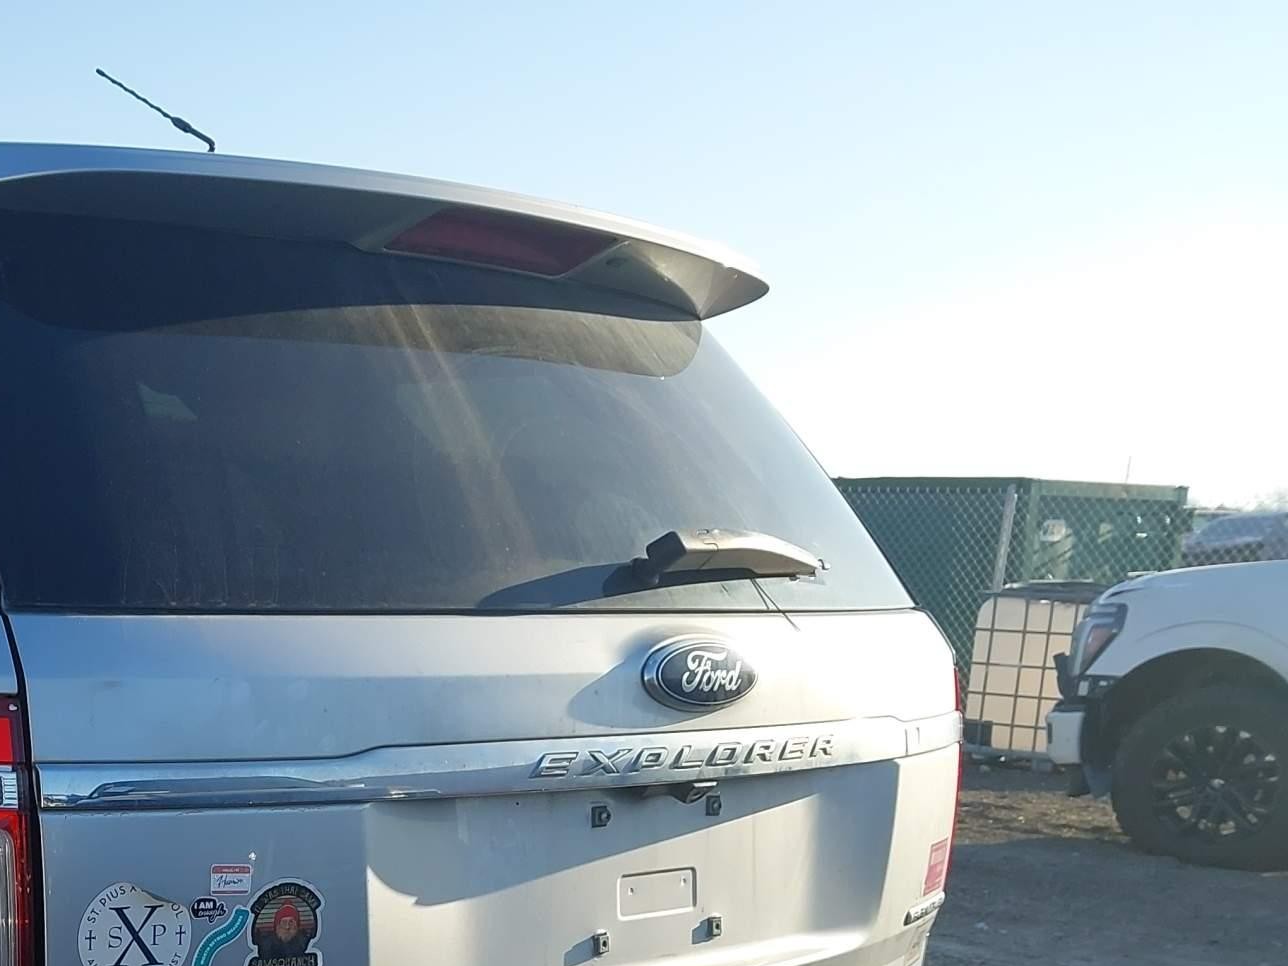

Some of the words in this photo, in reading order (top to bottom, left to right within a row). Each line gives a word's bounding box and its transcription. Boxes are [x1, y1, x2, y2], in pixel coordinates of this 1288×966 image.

[681, 650, 743, 693] Ford
[528, 734, 835, 778] EXPLORER
[99, 885, 127, 908] PIUS
[199, 901, 214, 909] AM
